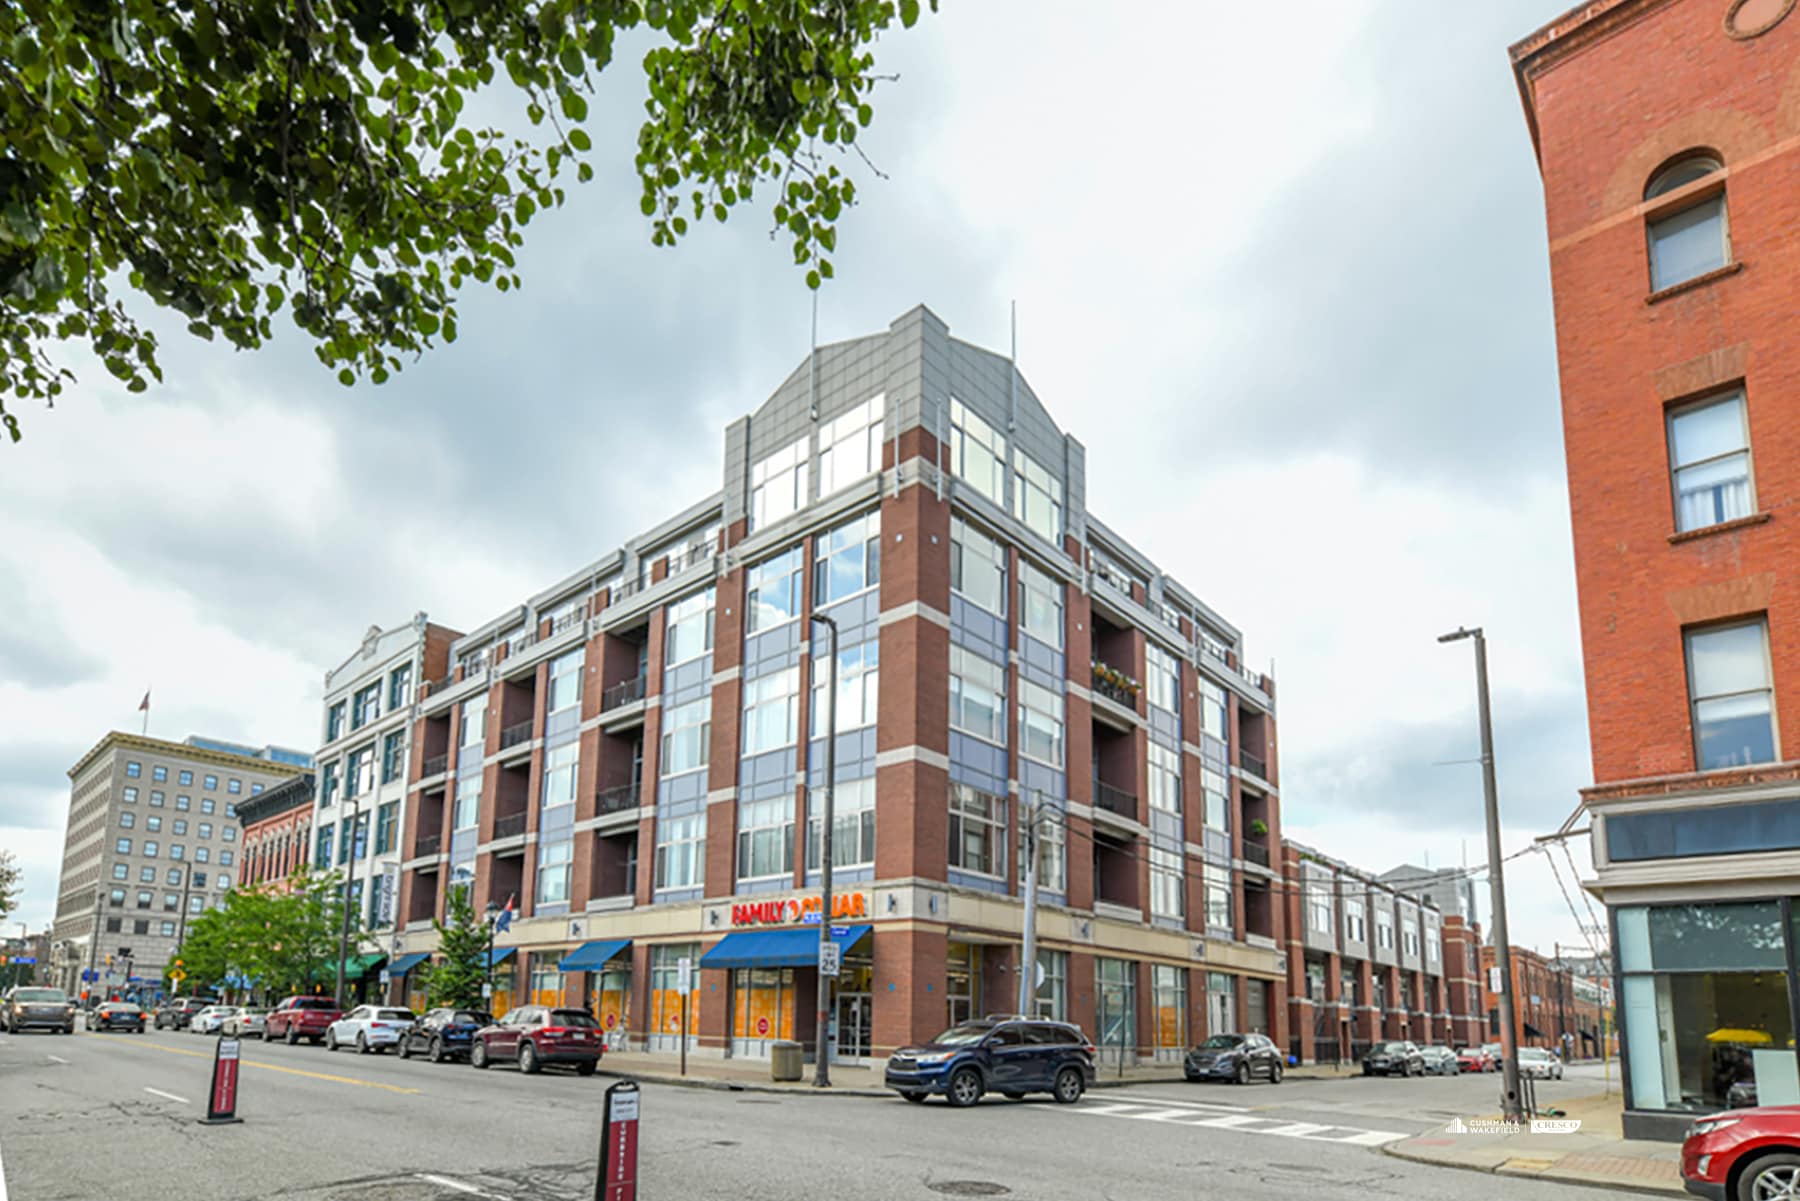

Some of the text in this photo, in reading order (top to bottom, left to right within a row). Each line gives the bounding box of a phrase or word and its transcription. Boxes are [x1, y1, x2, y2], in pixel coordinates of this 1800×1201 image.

[732, 893, 865, 924] FAMILY DOLAR
[822, 959, 837, 972] 25
